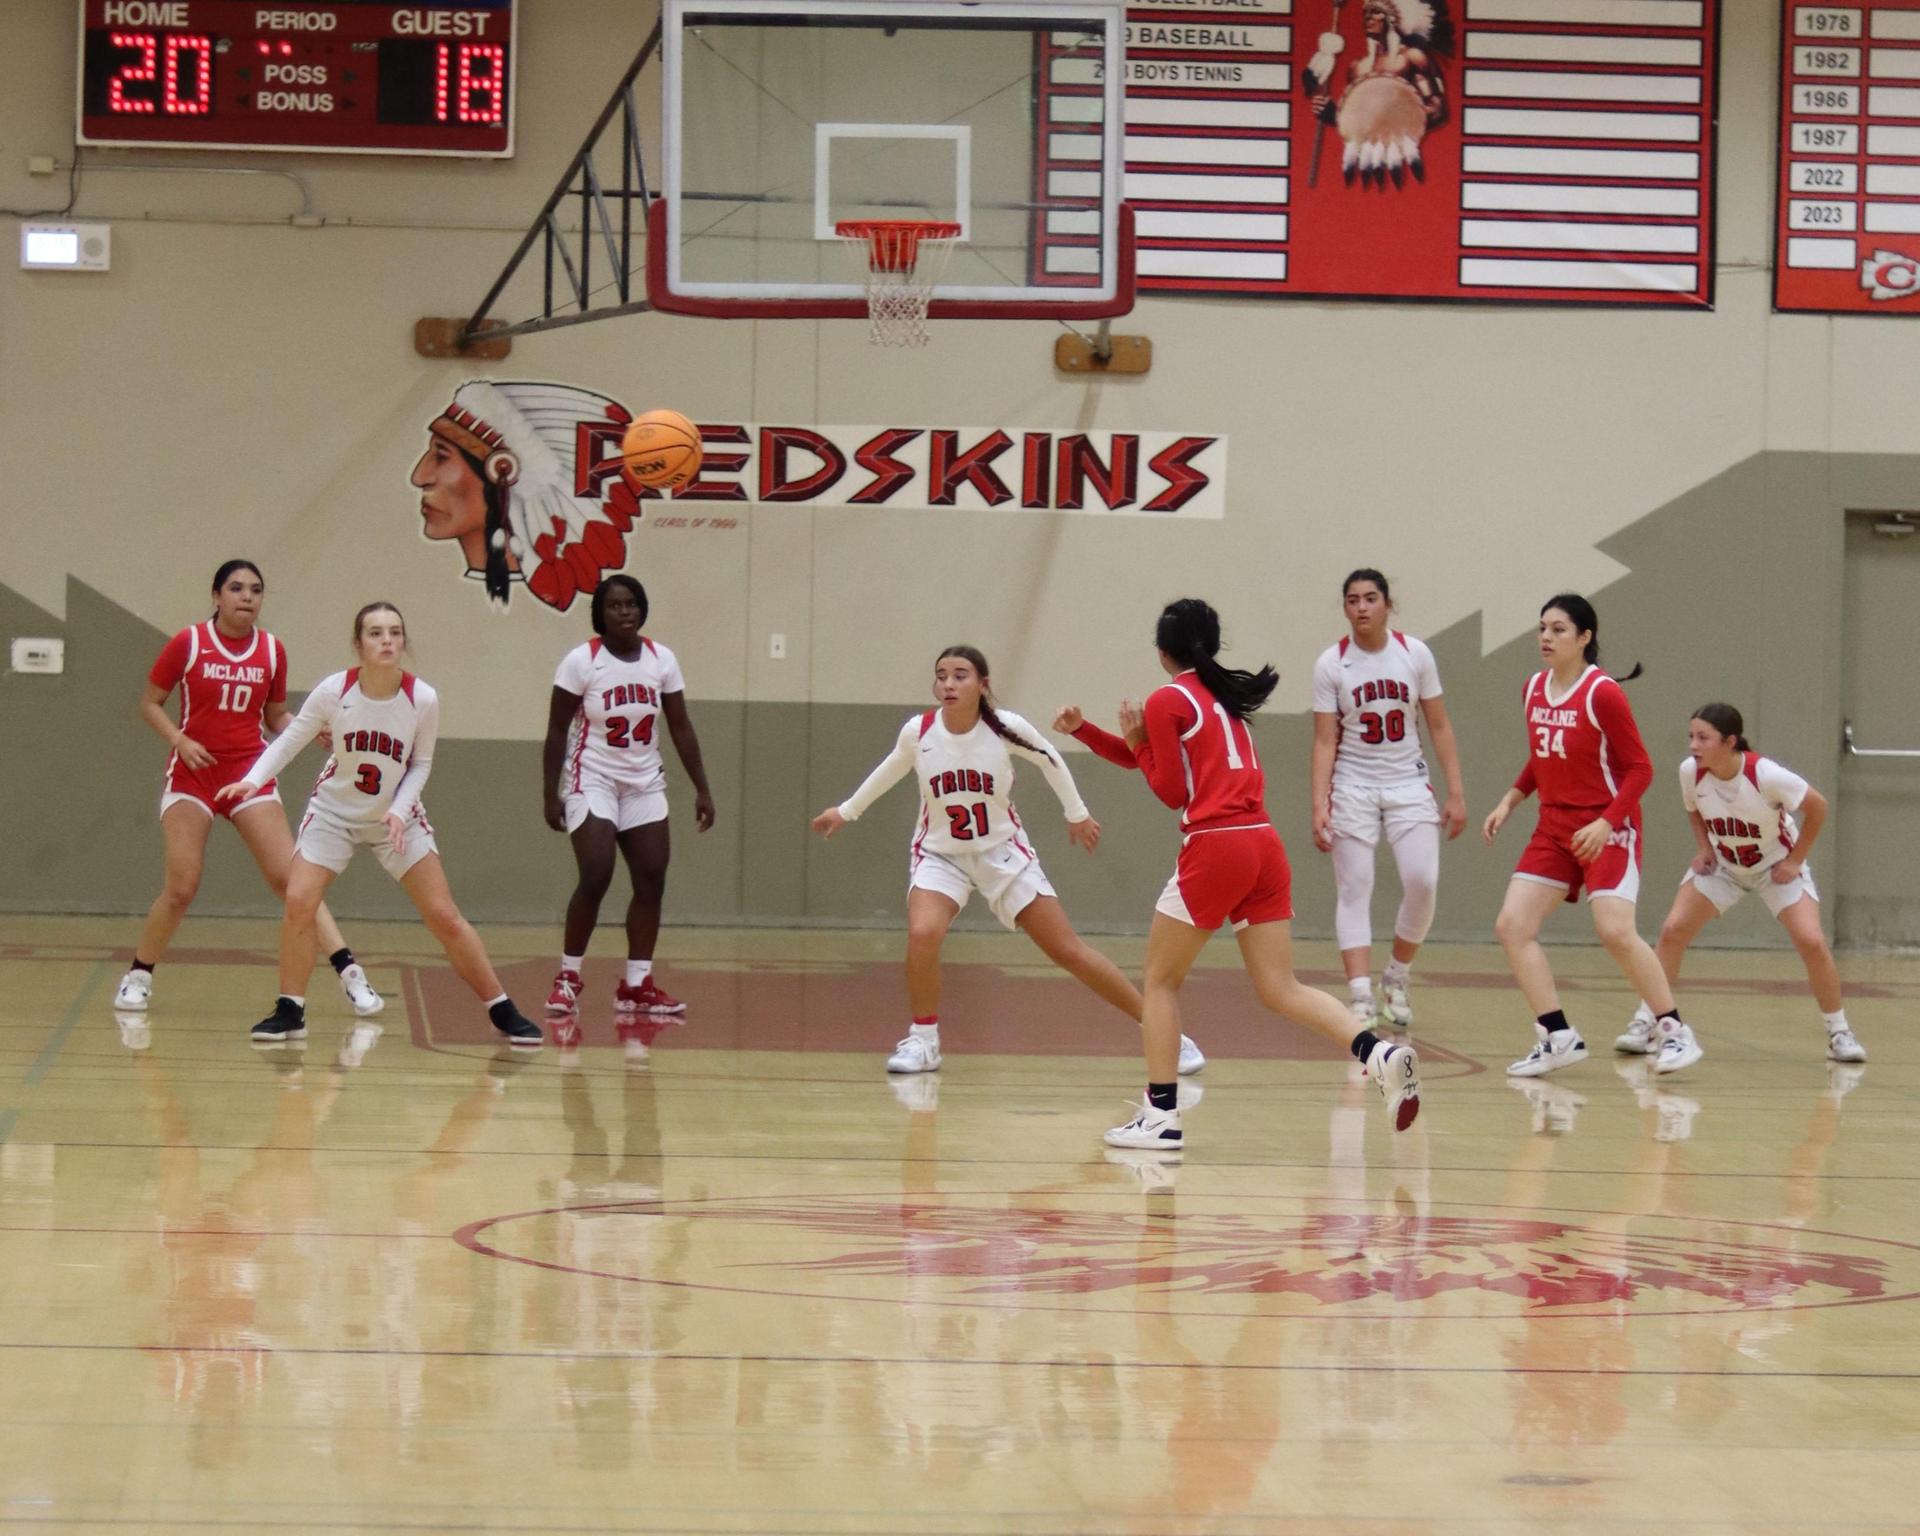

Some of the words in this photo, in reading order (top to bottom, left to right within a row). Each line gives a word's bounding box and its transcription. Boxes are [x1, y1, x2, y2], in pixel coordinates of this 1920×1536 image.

[103, 2, 189, 27] HOME
[255, 11, 337, 31] PERIOD
[391, 9, 491, 36] GUEST
[1805, 14, 1851, 32] 1978
[1139, 27, 1254, 47] BASEBALL
[110, 33, 211, 114] 20
[1134, 64, 1179, 81] BOYS
[1185, 66, 1243, 82] TENNIS
[1804, 51, 1849, 70] 1982
[264, 64, 327, 85] POSS
[433, 43, 504, 122] 18
[256, 91, 334, 113] BONUS
[1803, 90, 1849, 108] 1986
[1802, 129, 1847, 146] 1987
[1804, 168, 1844, 186] 2022
[1803, 206, 1843, 224] 2023
[574, 420, 1219, 513] REDSKINS
[202, 662, 265, 684] MCLANE
[218, 683, 253, 713] 10
[602, 683, 659, 711] TRIBE
[1351, 679, 1410, 708] TRIBE
[1359, 708, 1405, 744] 30
[1530, 706, 1579, 728] MCLANE
[605, 714, 656, 748] 24
[1535, 726, 1568, 760] 34
[343, 730, 405, 763] TRIBE
[354, 763, 382, 795] 3
[929, 769, 995, 798] TRIBE
[945, 802, 990, 840] 21
